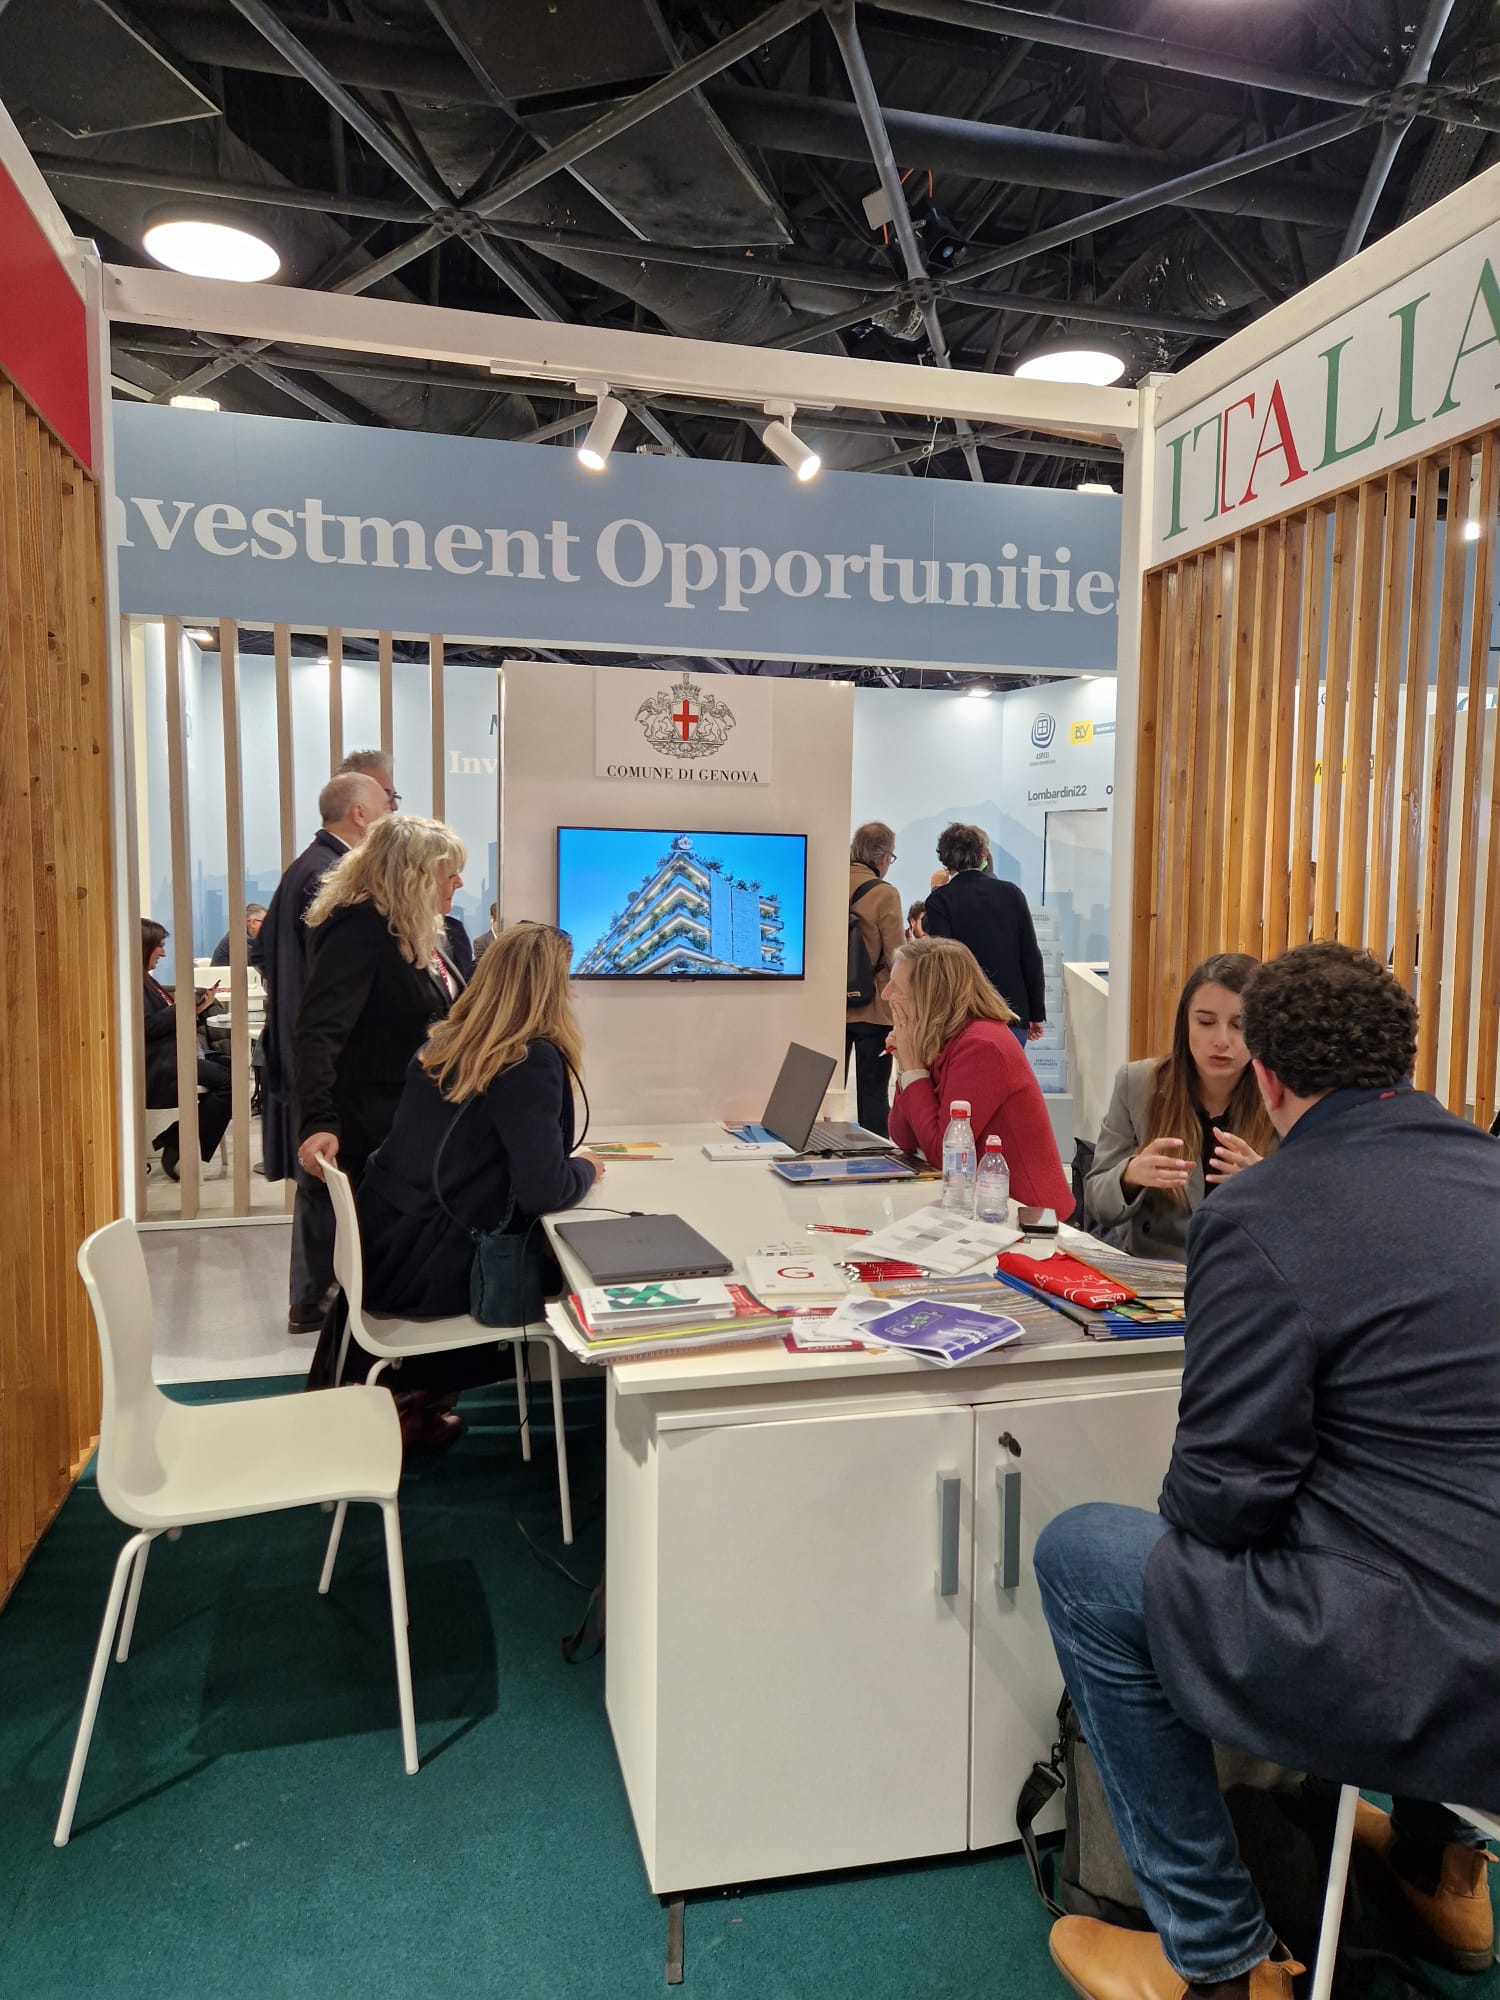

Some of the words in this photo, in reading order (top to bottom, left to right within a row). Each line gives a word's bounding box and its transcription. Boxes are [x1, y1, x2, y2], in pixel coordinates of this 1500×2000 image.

[1163, 257, 1500, 541] ITALIA
[596, 519, 1119, 616] Opportunitie
[607, 765, 673, 780] COMUNE
[678, 767, 696, 781] DI
[698, 768, 759, 783] GENOVA
[1028, 785, 1087, 801] Lombardini22
